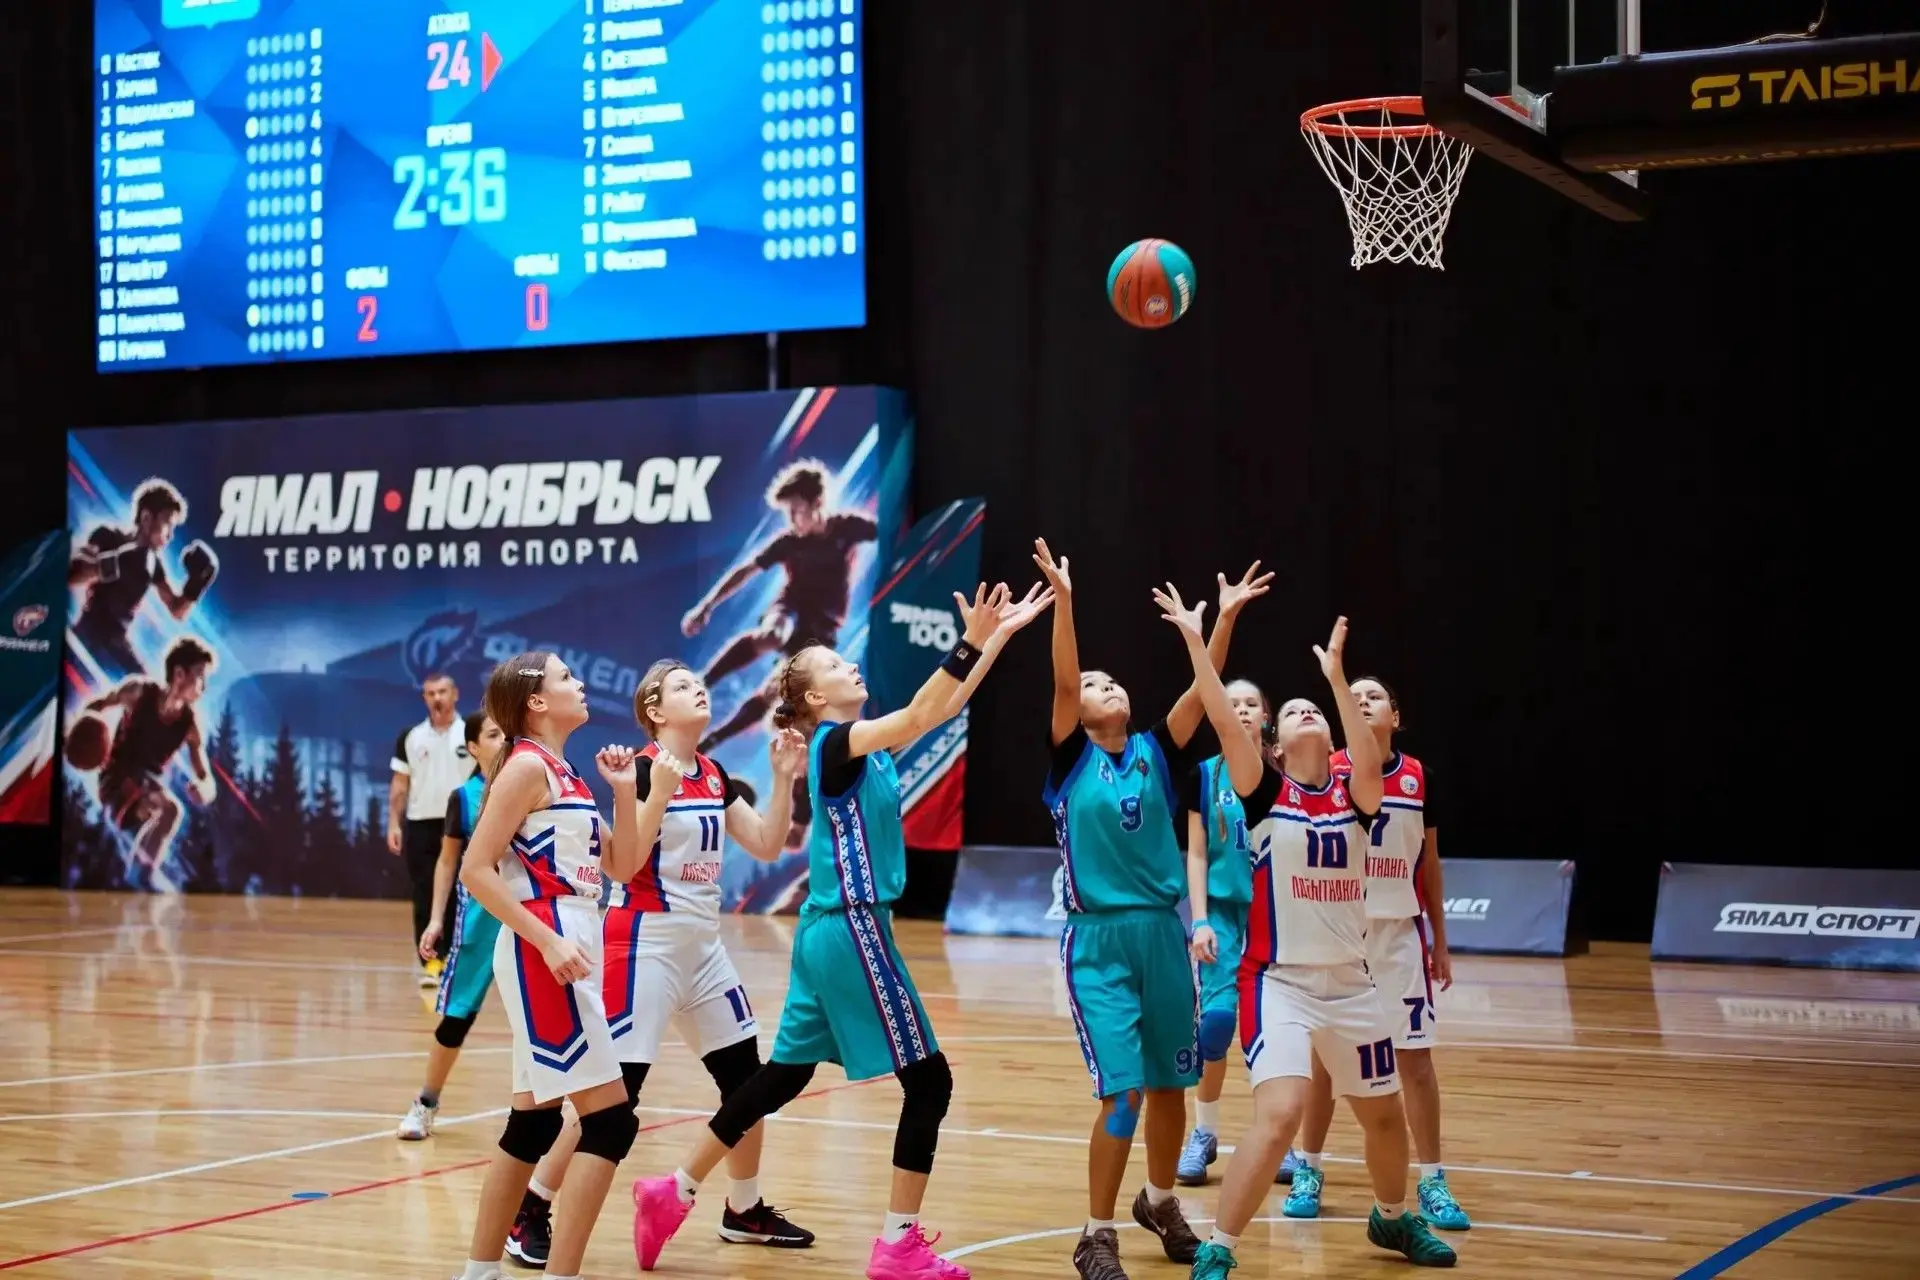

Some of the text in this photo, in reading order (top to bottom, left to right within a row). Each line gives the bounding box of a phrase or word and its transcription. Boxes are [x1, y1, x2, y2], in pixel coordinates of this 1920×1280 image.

[427, 39, 471, 91] 24
[1749, 60, 1920, 104] TAISH
[393, 147, 507, 231] 2:36
[356, 296, 378, 341] 2
[525, 283, 548, 331] 0
[214, 456, 722, 537] ЯМАЛ НОЯБРЬСК
[264, 537, 639, 572] ТЕРРИТОРИЯ СПОРТА
[699, 816, 719, 851] 11
[1119, 796, 1143, 833] 9
[1370, 813, 1390, 846] 7
[1306, 829, 1347, 868] 10
[1727, 910, 1915, 932] ЯМАЛ СПОРТ
[1402, 997, 1425, 1031] 7
[1174, 1046, 1194, 1077] 9
[1356, 1036, 1395, 1080] 10
